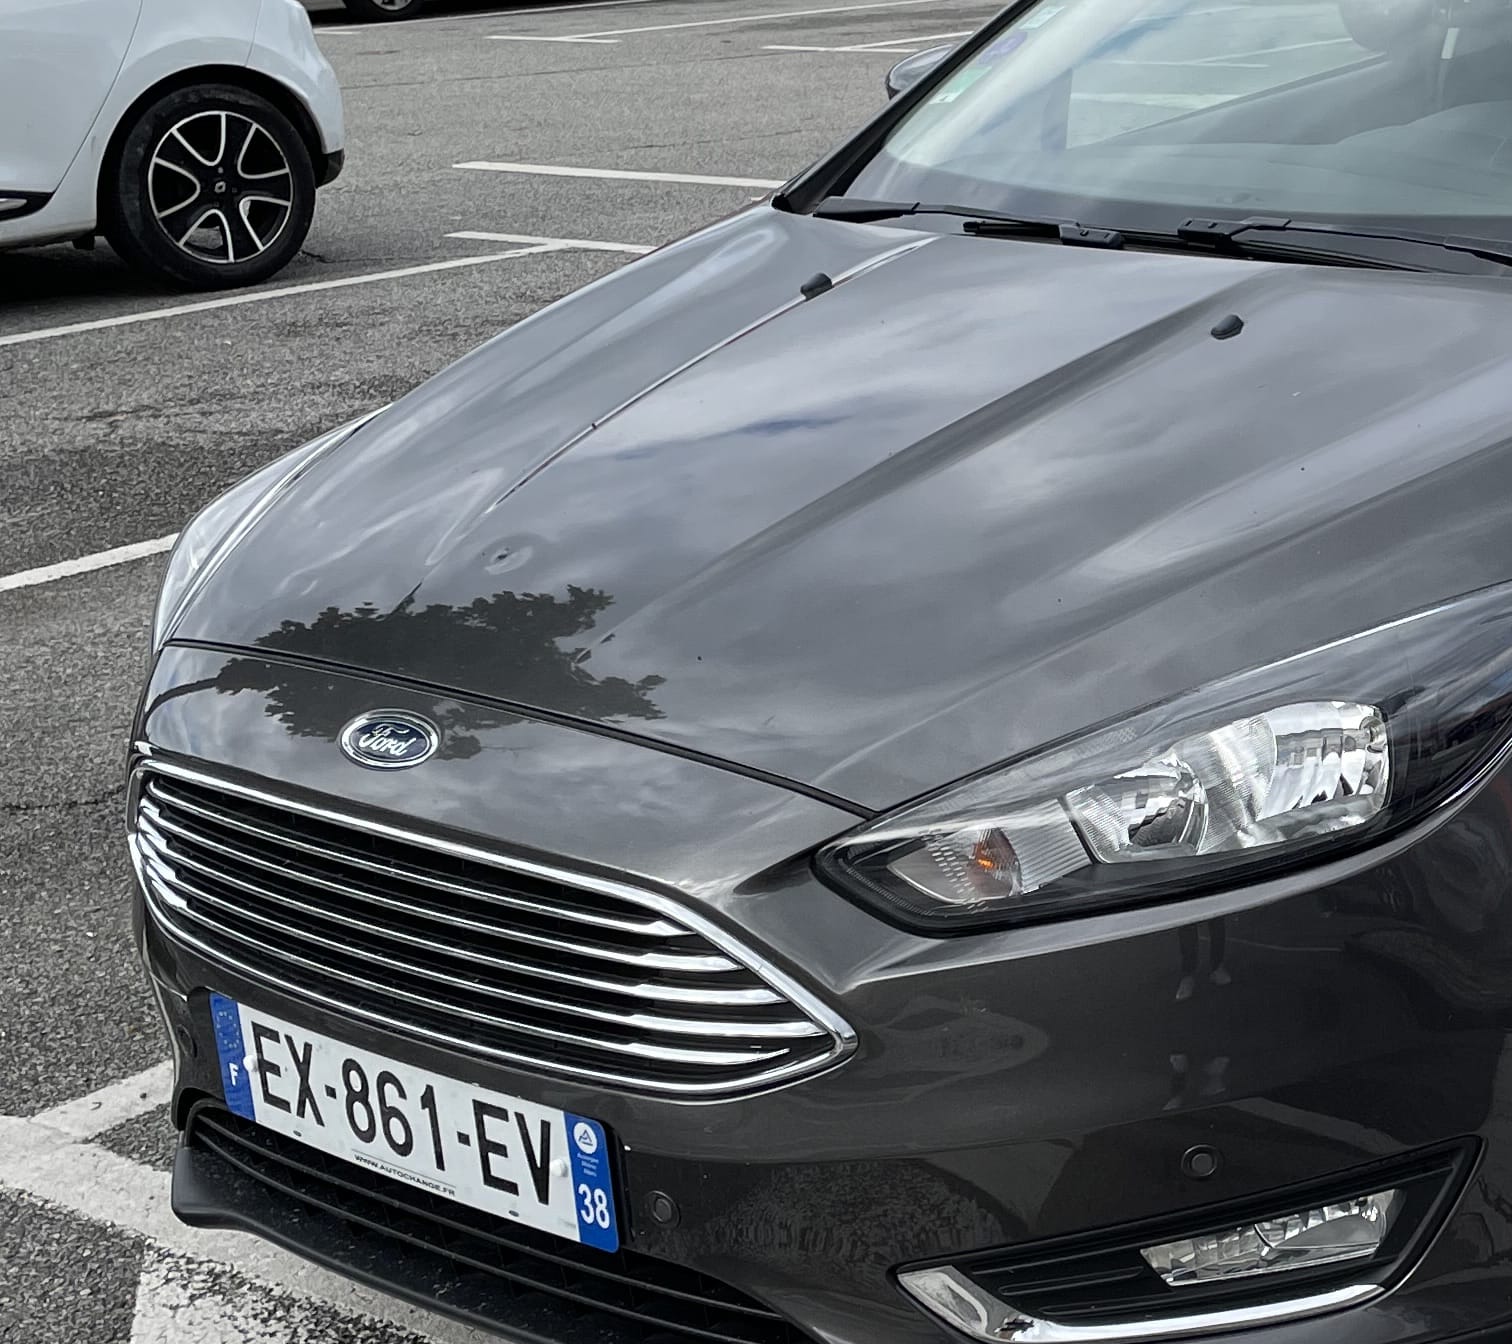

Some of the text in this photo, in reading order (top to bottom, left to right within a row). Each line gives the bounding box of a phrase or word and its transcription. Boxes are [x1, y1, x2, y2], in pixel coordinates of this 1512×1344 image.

[359, 723, 417, 756] Ford
[229, 1062, 239, 1086] F
[251, 1020, 551, 1206] EX-861-EV
[578, 1183, 610, 1230] 38
